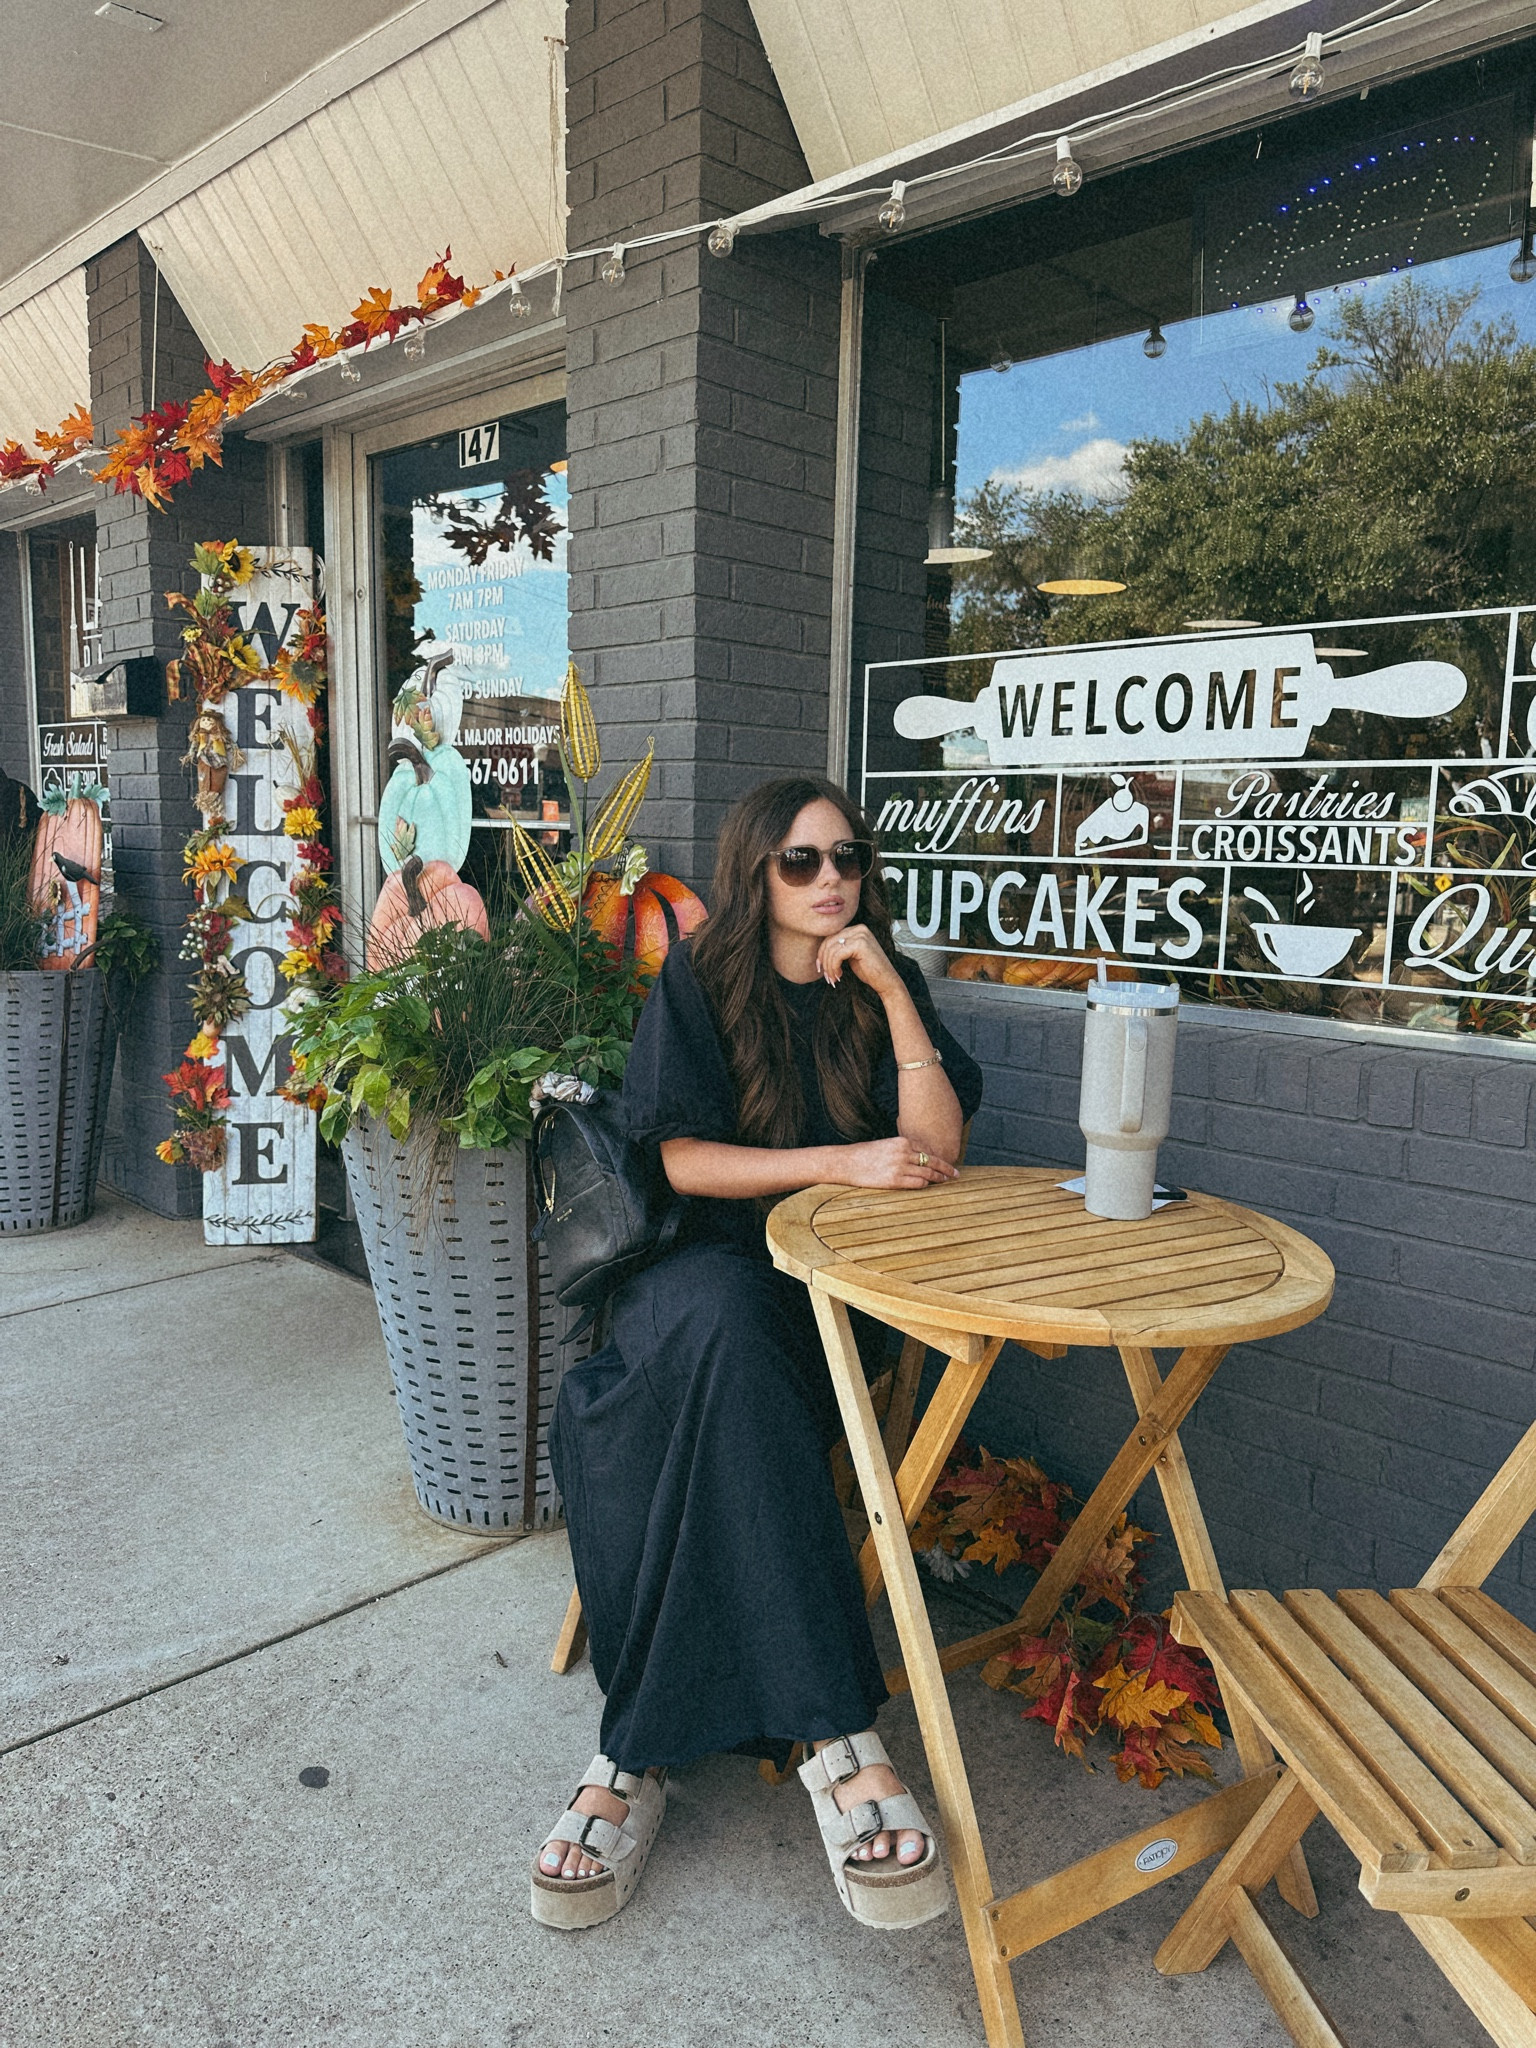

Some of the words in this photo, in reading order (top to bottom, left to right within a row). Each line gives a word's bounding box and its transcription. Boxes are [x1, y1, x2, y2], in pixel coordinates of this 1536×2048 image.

[460, 423, 498, 467] 147
[427, 564, 478, 591] MONDAY
[480, 557, 524, 583] FRIDAY
[448, 590, 474, 611] 7AM
[477, 586, 504, 608] 7PM
[445, 617, 506, 643] SATURDAY
[453, 645, 473, 667] AM
[476, 676, 524, 700] SUNDAY
[998, 666, 1302, 739] WELCOME
[43, 732, 65, 757] Fresh
[66, 731, 94, 757] Salads
[465, 727, 503, 746] MAJOR
[505, 725, 560, 746] HOLIDAYS
[1214, 771, 1396, 819] Pastries
[873, 776, 1046, 853] muffins
[1191, 824, 1419, 867] CROISSANTS
